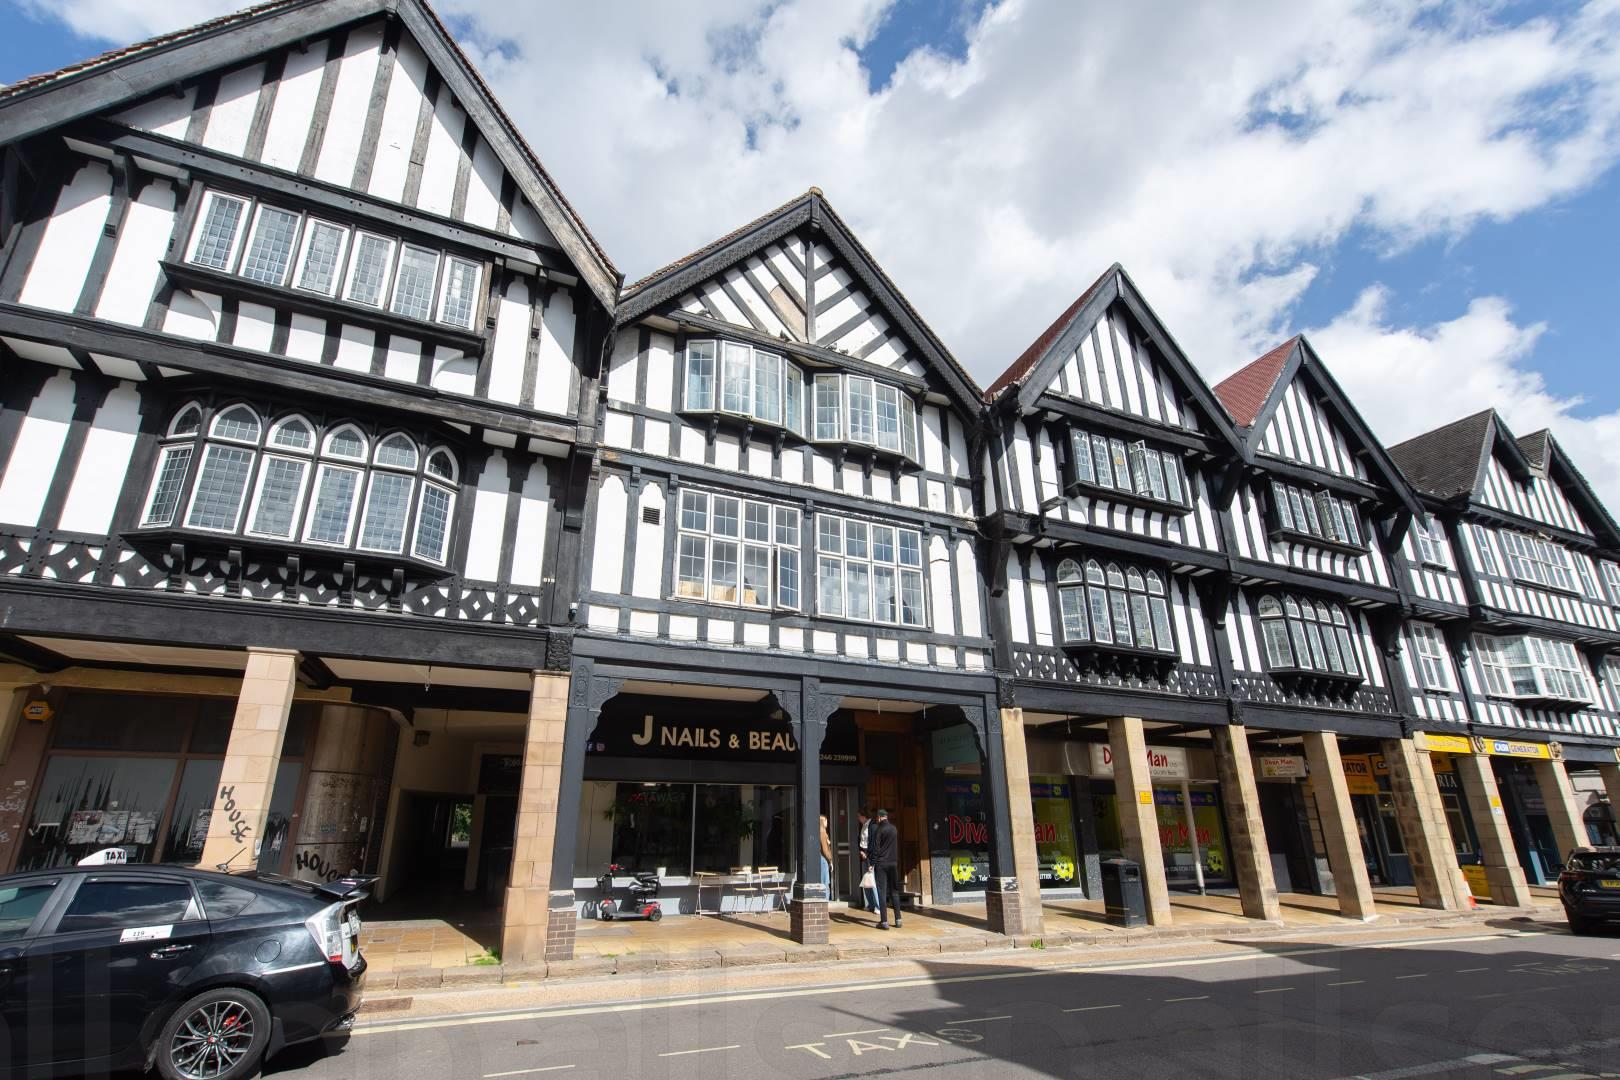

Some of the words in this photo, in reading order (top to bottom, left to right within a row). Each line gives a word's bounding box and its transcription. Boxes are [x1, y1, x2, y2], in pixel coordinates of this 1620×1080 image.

[632, 715, 654, 746] J
[661, 726, 721, 749] NAILS
[728, 733, 740, 749] &
[220, 785, 252, 844] HOUSE
[105, 851, 126, 861] TAXI
[784, 1028, 984, 1059] TAXIS
